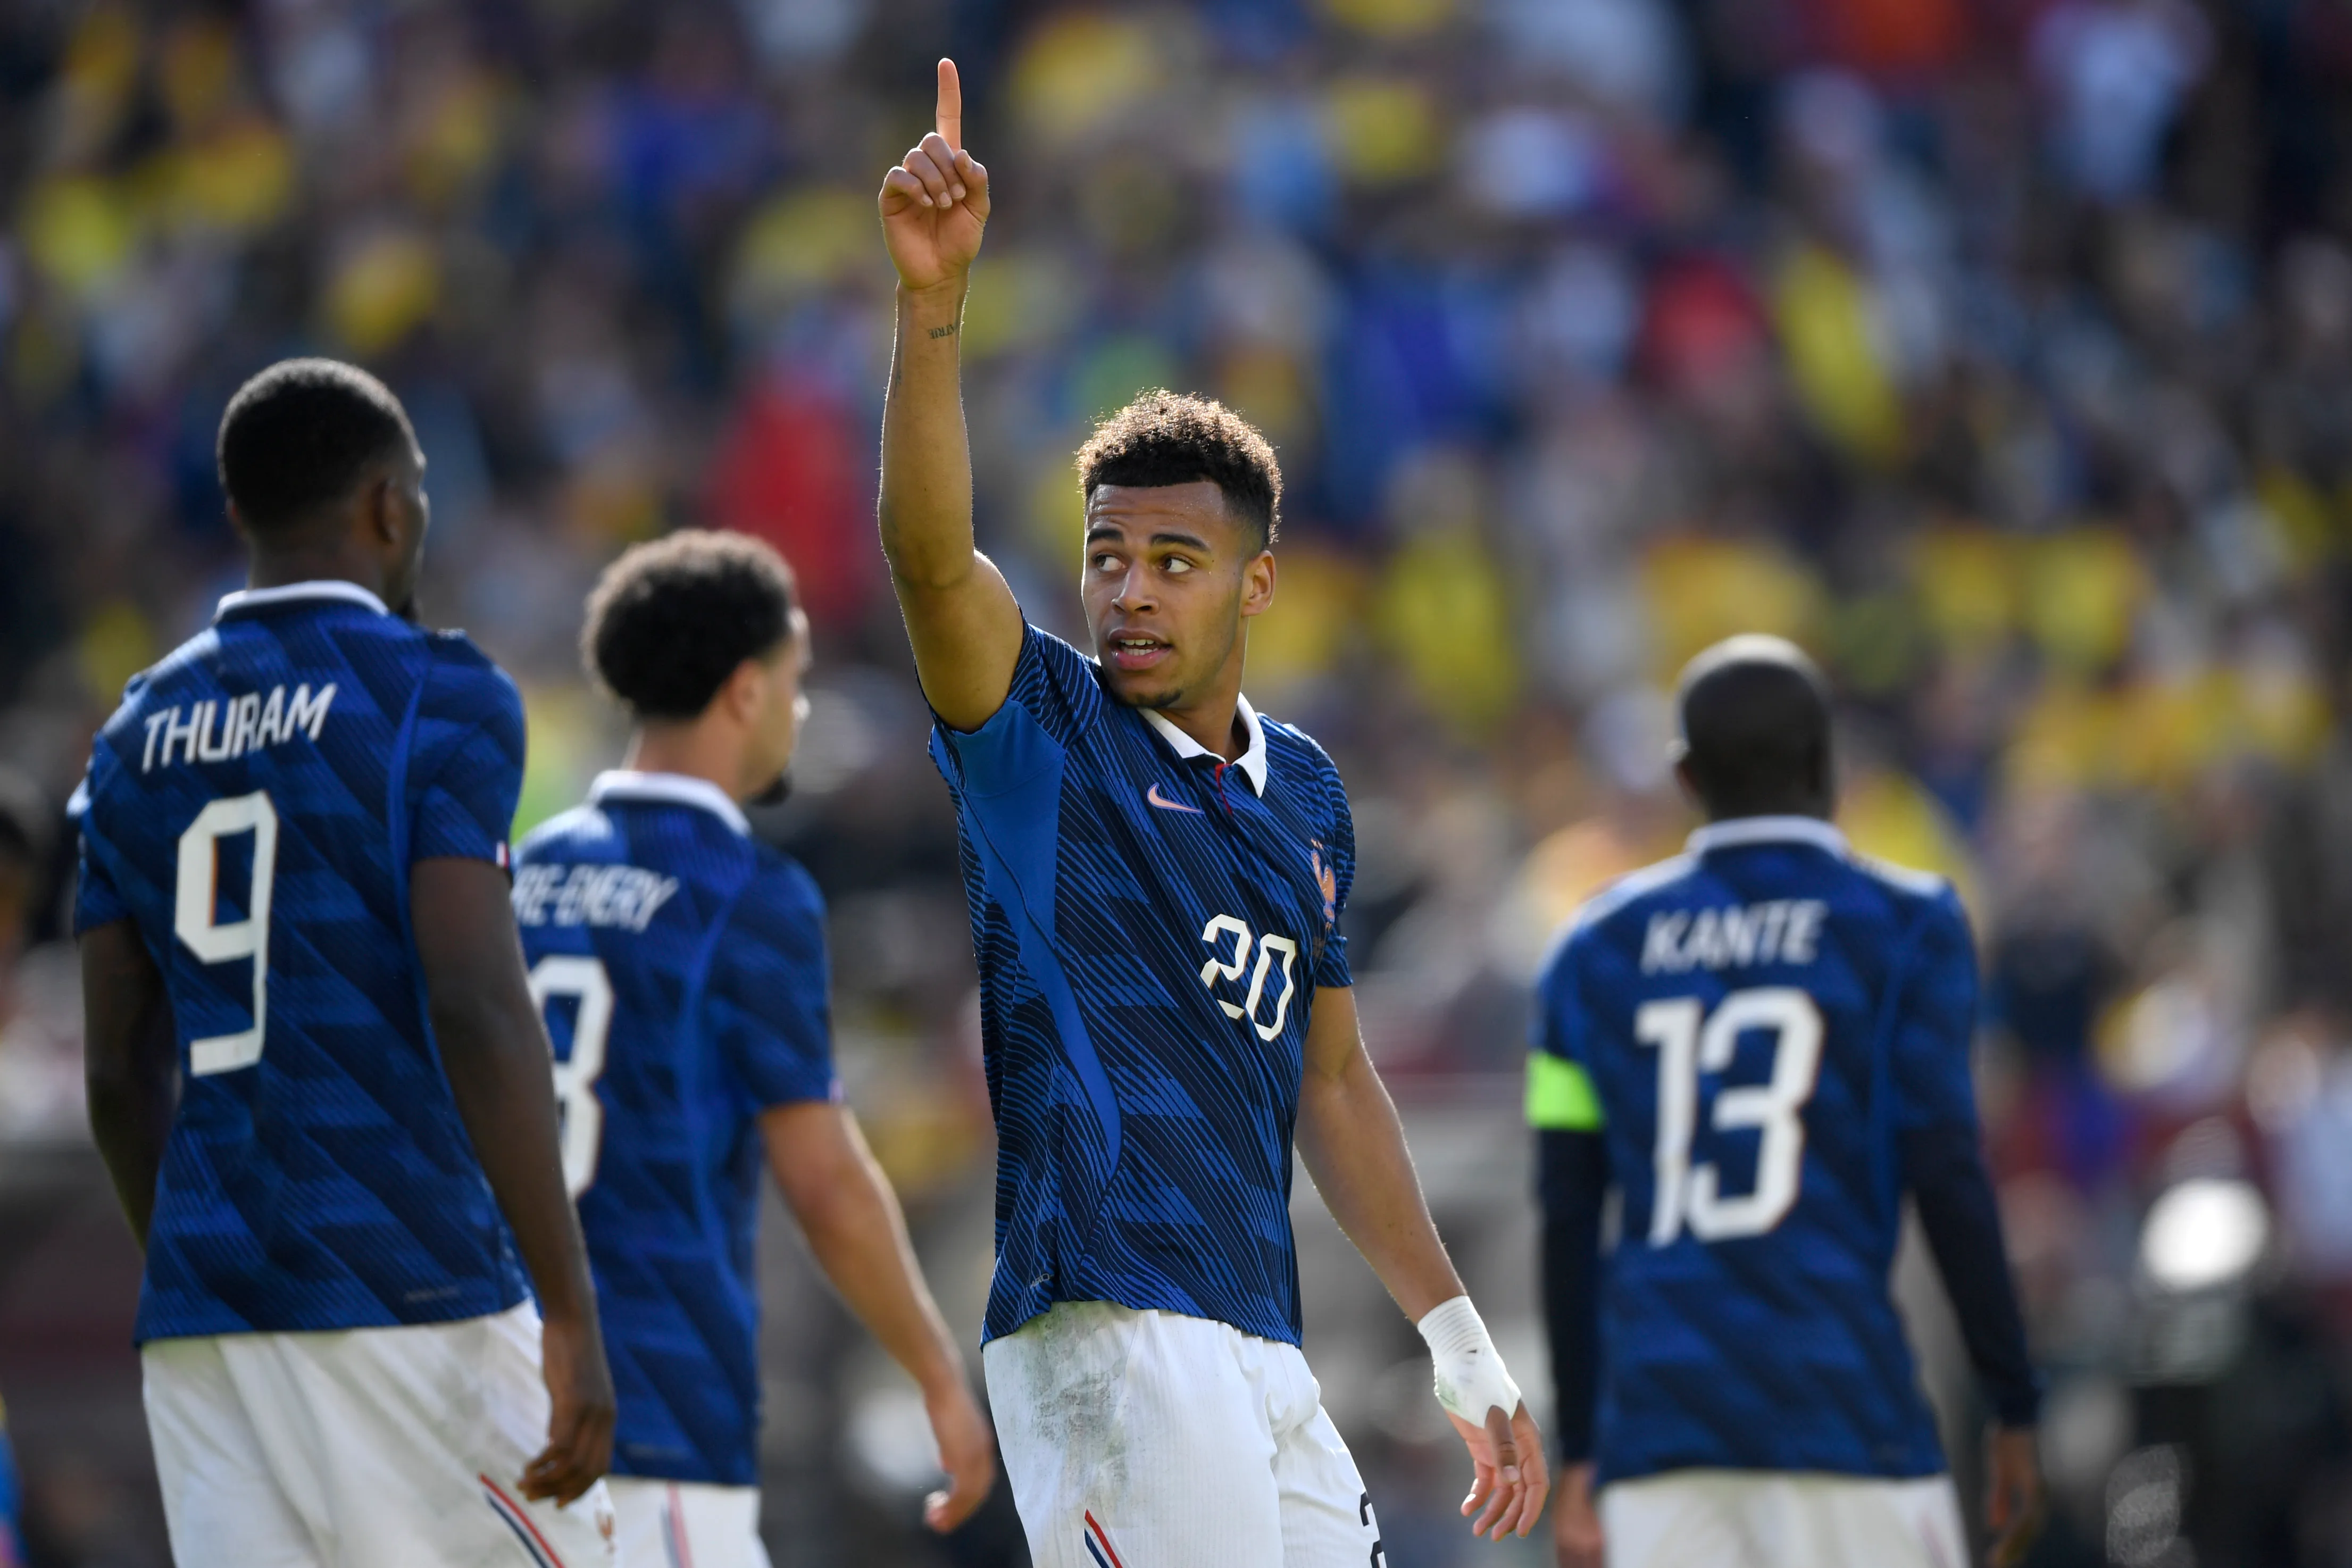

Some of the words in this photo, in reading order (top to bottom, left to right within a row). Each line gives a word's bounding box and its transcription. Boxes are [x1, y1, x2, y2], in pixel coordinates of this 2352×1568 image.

[143, 683, 338, 774] THURAM
[174, 789, 279, 1077] 9
[1200, 913, 1297, 1042] 20
[1639, 898, 1830, 977] KANTE
[1634, 985, 1826, 1249] 13
